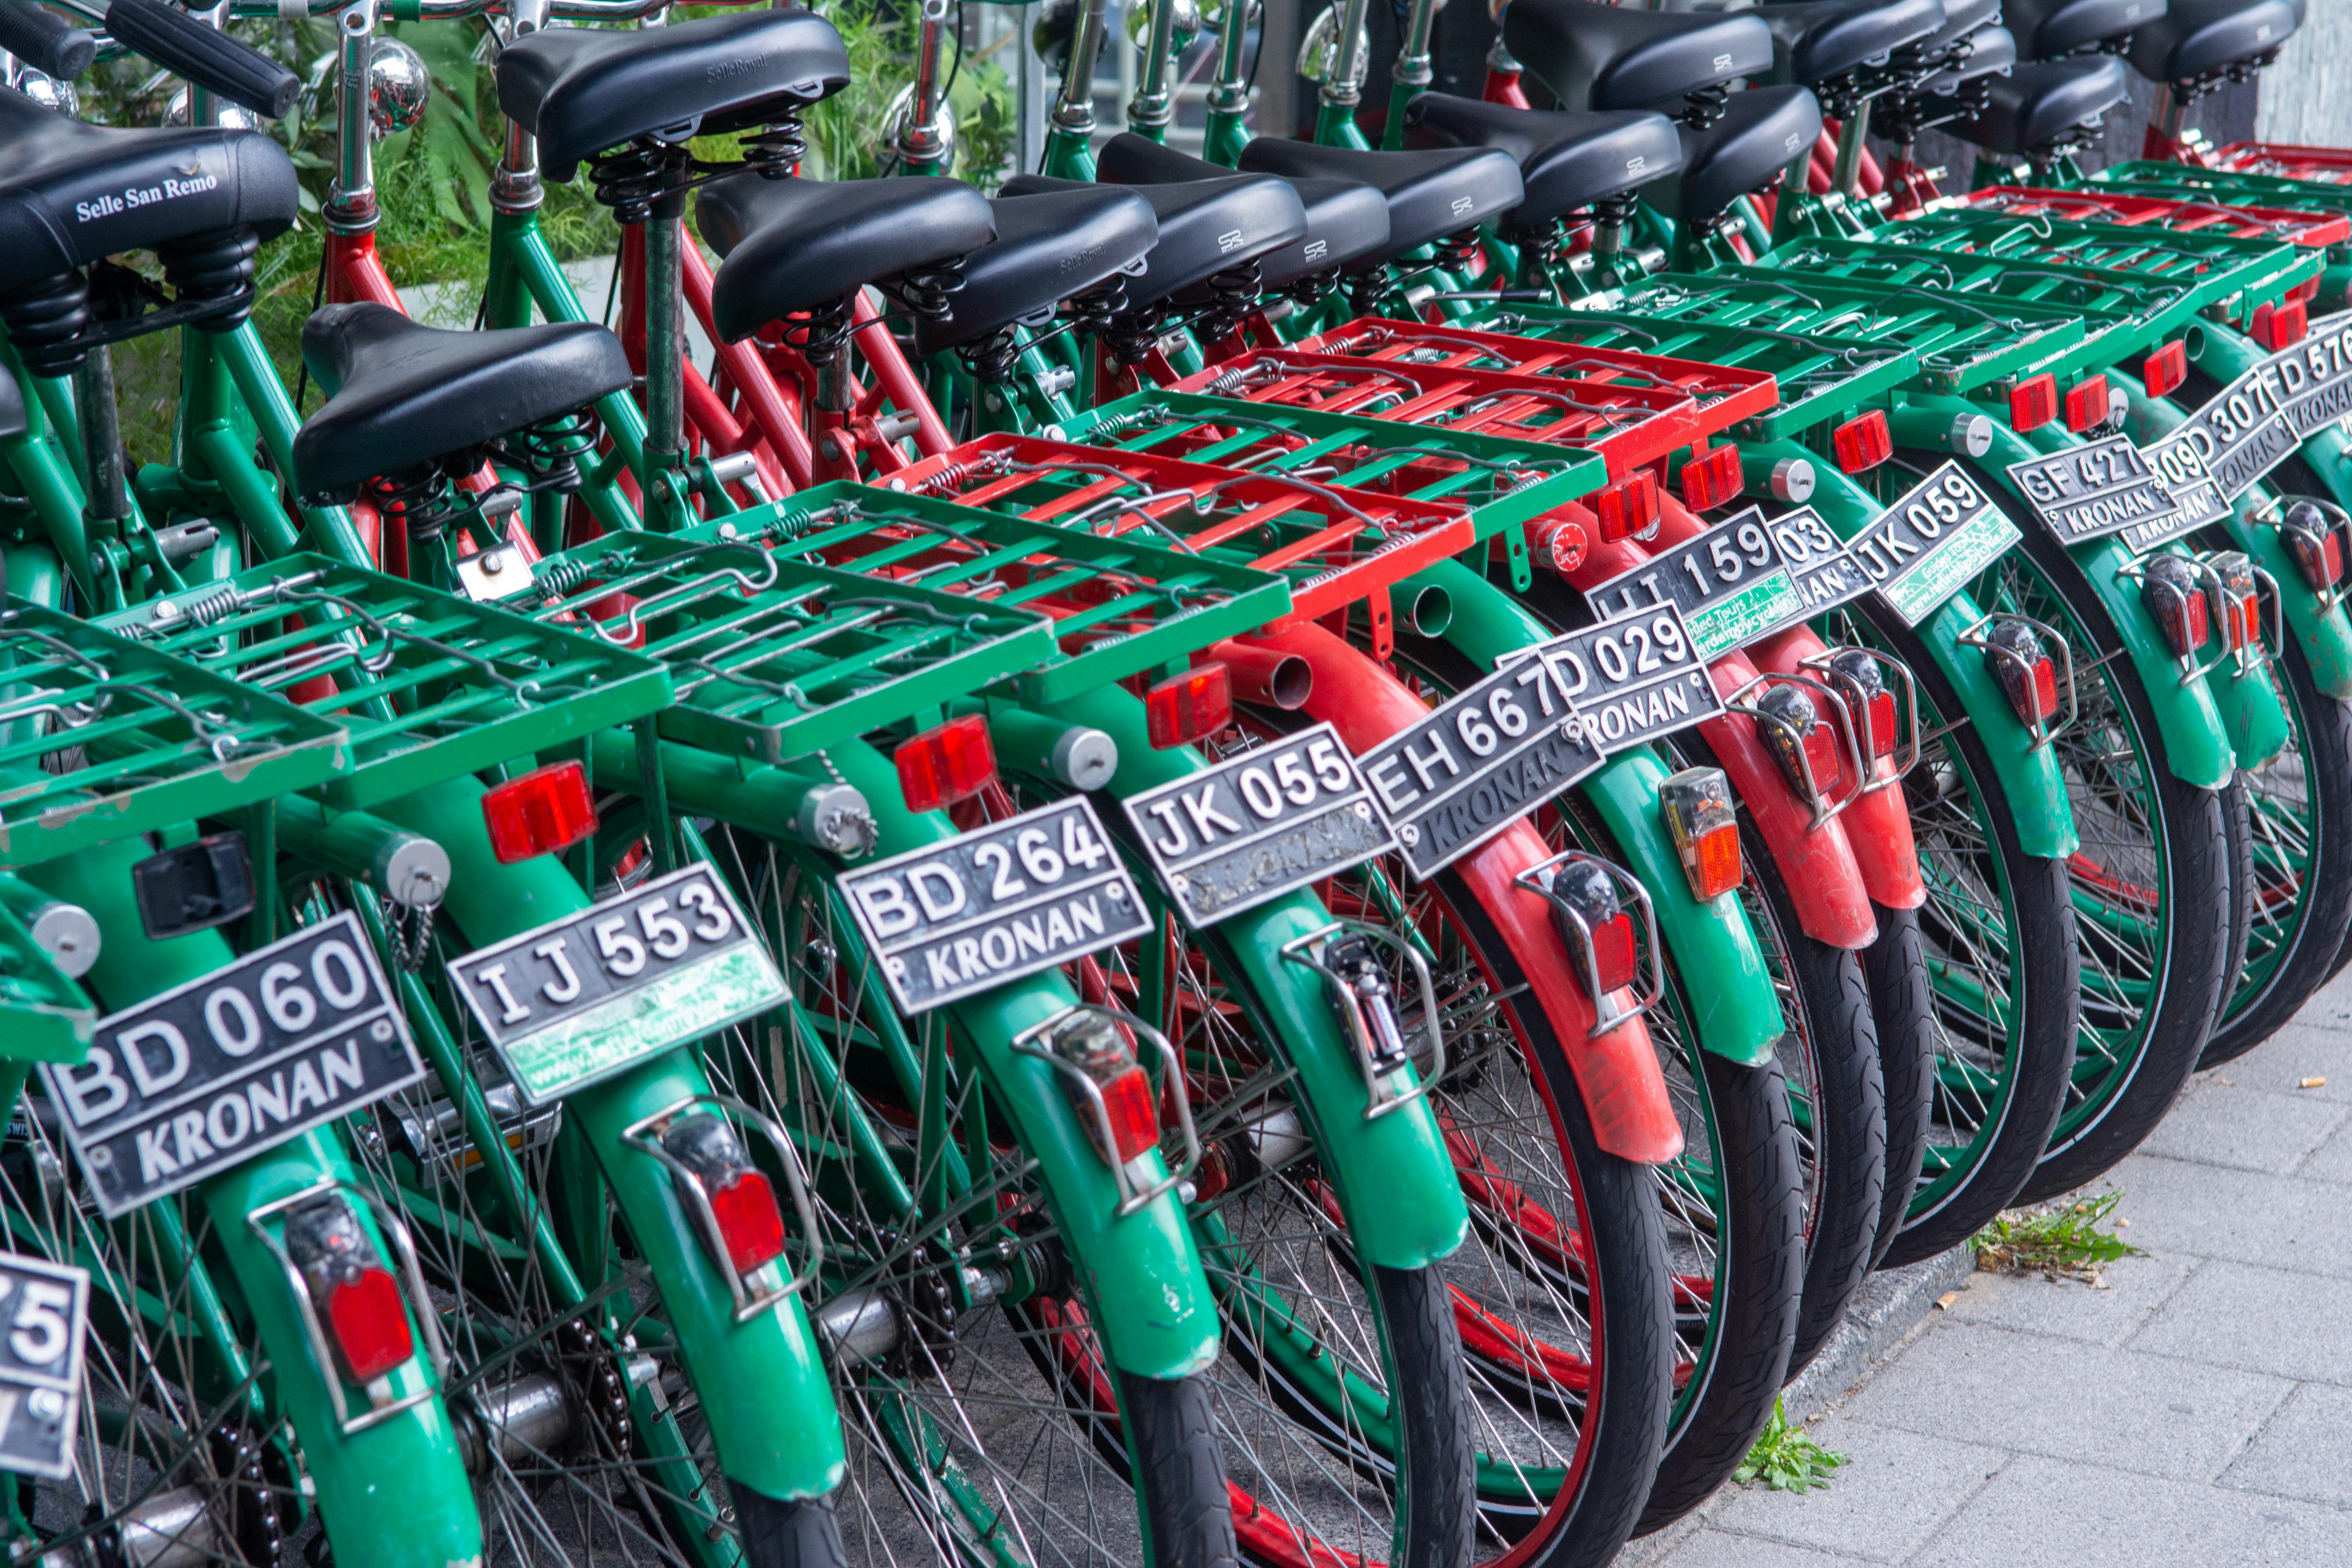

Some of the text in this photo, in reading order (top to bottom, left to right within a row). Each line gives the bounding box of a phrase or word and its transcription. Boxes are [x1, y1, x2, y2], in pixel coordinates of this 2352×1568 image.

[76, 175, 218, 223] Selle San Remo
[2211, 376, 2269, 443] 307
[2287, 378, 2352, 431] KRONA
[2021, 441, 2141, 503] GF 427
[2064, 488, 2155, 534] KRONAN
[1684, 523, 1770, 597] 159
[1776, 517, 1833, 562] 03
[1858, 475, 1977, 580] JK 059
[1545, 616, 1686, 697] D 029
[1367, 662, 1554, 815] EH 667
[1150, 738, 1351, 857] JK 055
[1427, 740, 1568, 854] KRONAN
[855, 862, 966, 939] BD
[974, 815, 1107, 901] 264
[593, 882, 733, 977] 553
[925, 894, 1105, 989] KRONAN
[51, 939, 368, 1127] BD 060
[134, 1038, 365, 1183] KRONAN
[0, 1273, 70, 1365] 5
